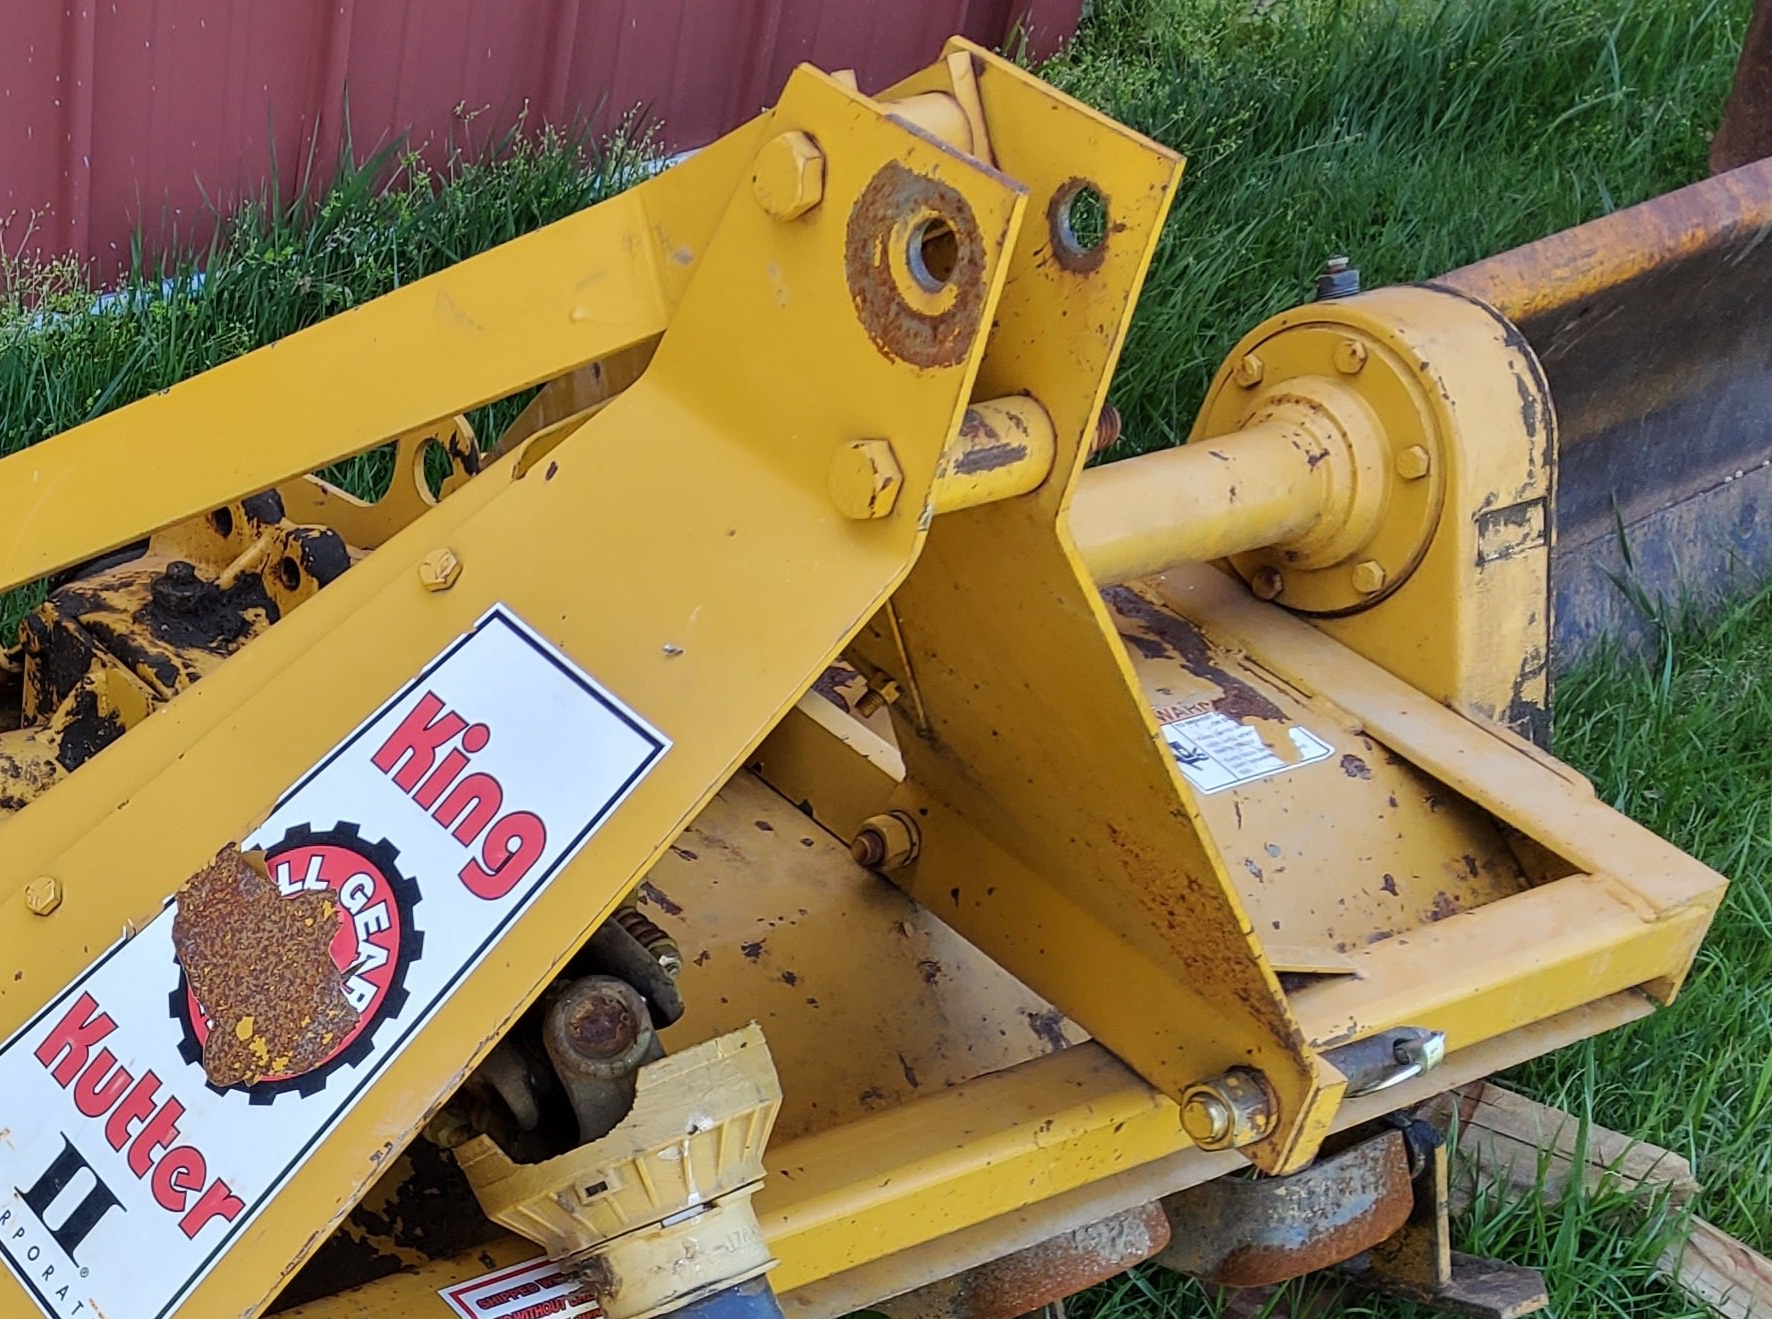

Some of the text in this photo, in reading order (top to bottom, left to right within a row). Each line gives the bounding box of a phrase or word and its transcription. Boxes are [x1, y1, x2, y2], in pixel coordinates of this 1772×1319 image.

[370, 689, 547, 901] King
[276, 854, 393, 1014] LL GEAR
[33, 990, 246, 1240] Kutter
[14, 1131, 127, 1268] II
[476, 1282, 540, 1310] SHIPPED
